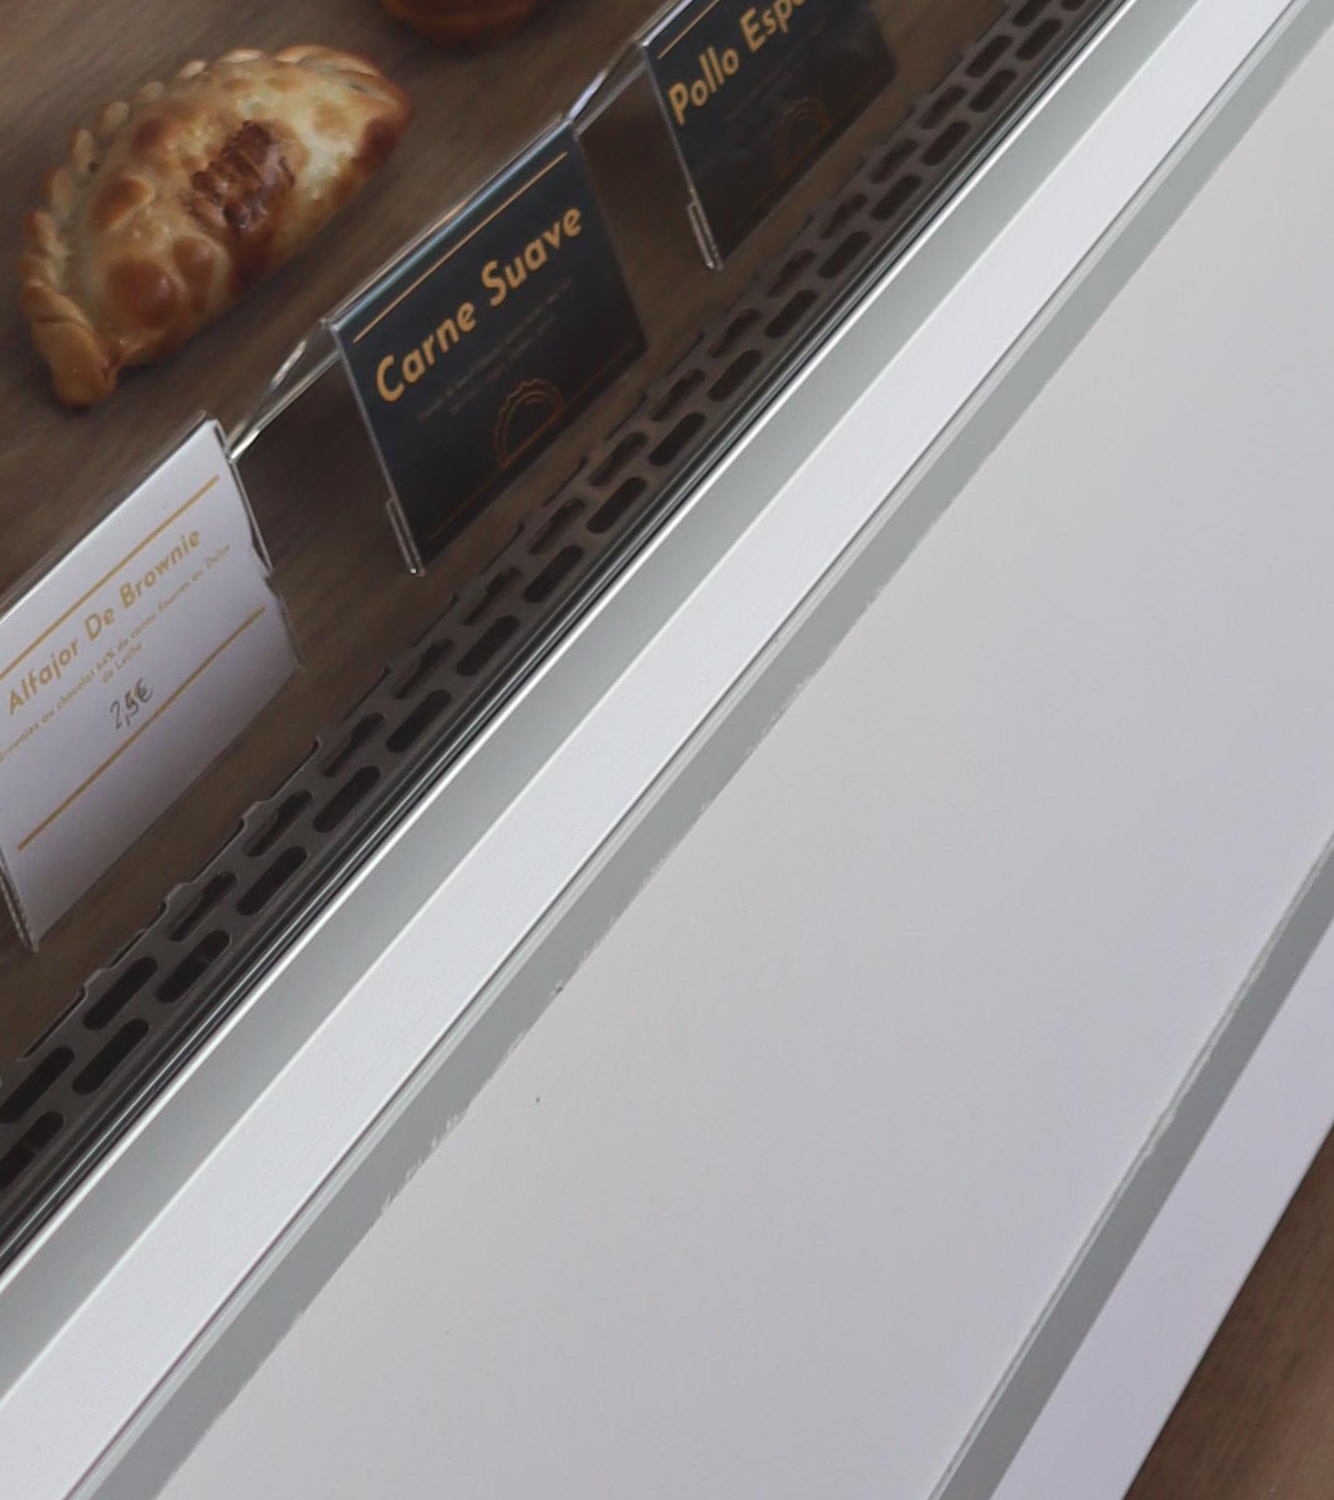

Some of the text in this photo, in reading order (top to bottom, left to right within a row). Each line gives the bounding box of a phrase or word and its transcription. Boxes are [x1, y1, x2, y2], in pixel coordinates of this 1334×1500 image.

[667, 44, 740, 128] Pollo
[375, 303, 476, 403] Carne
[480, 206, 583, 308] Suave
[7, 529, 202, 717] Alfajor De Brownie
